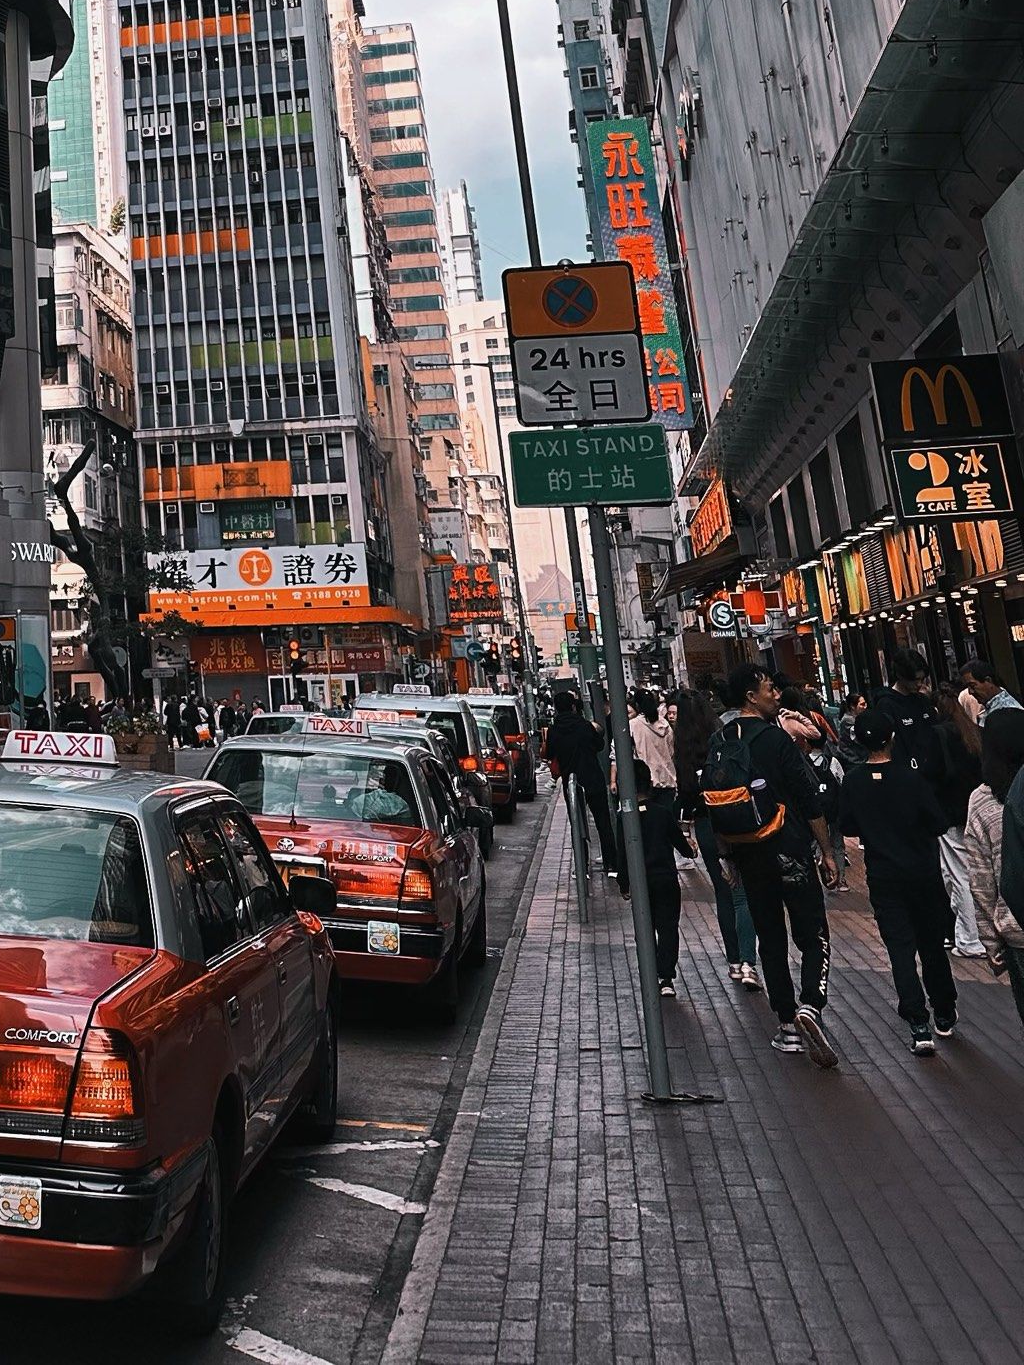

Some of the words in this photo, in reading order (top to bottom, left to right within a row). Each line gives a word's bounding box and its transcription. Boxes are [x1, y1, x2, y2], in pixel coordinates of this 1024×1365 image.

[529, 348, 570, 371] 24
[578, 346, 626, 369] hrs
[543, 380, 619, 412] 全日
[520, 439, 568, 458] TAXI
[577, 435, 654, 455] STAND
[547, 464, 636, 492] 的士站
[954, 448, 996, 510] 冰室
[917, 503, 926, 513] 2
[928, 500, 958, 512] CAFE
[157, 592, 278, 605] www.bsgroup.com.hk
[306, 590, 331, 601] 3188
[335, 589, 361, 599] 0928
[396, 684, 428, 694] TAXI
[308, 718, 363, 734] TAXI
[356, 711, 396, 722] TAXI
[14, 732, 104, 758] TAXI
[4, 1027, 80, 1044] COMFORT
